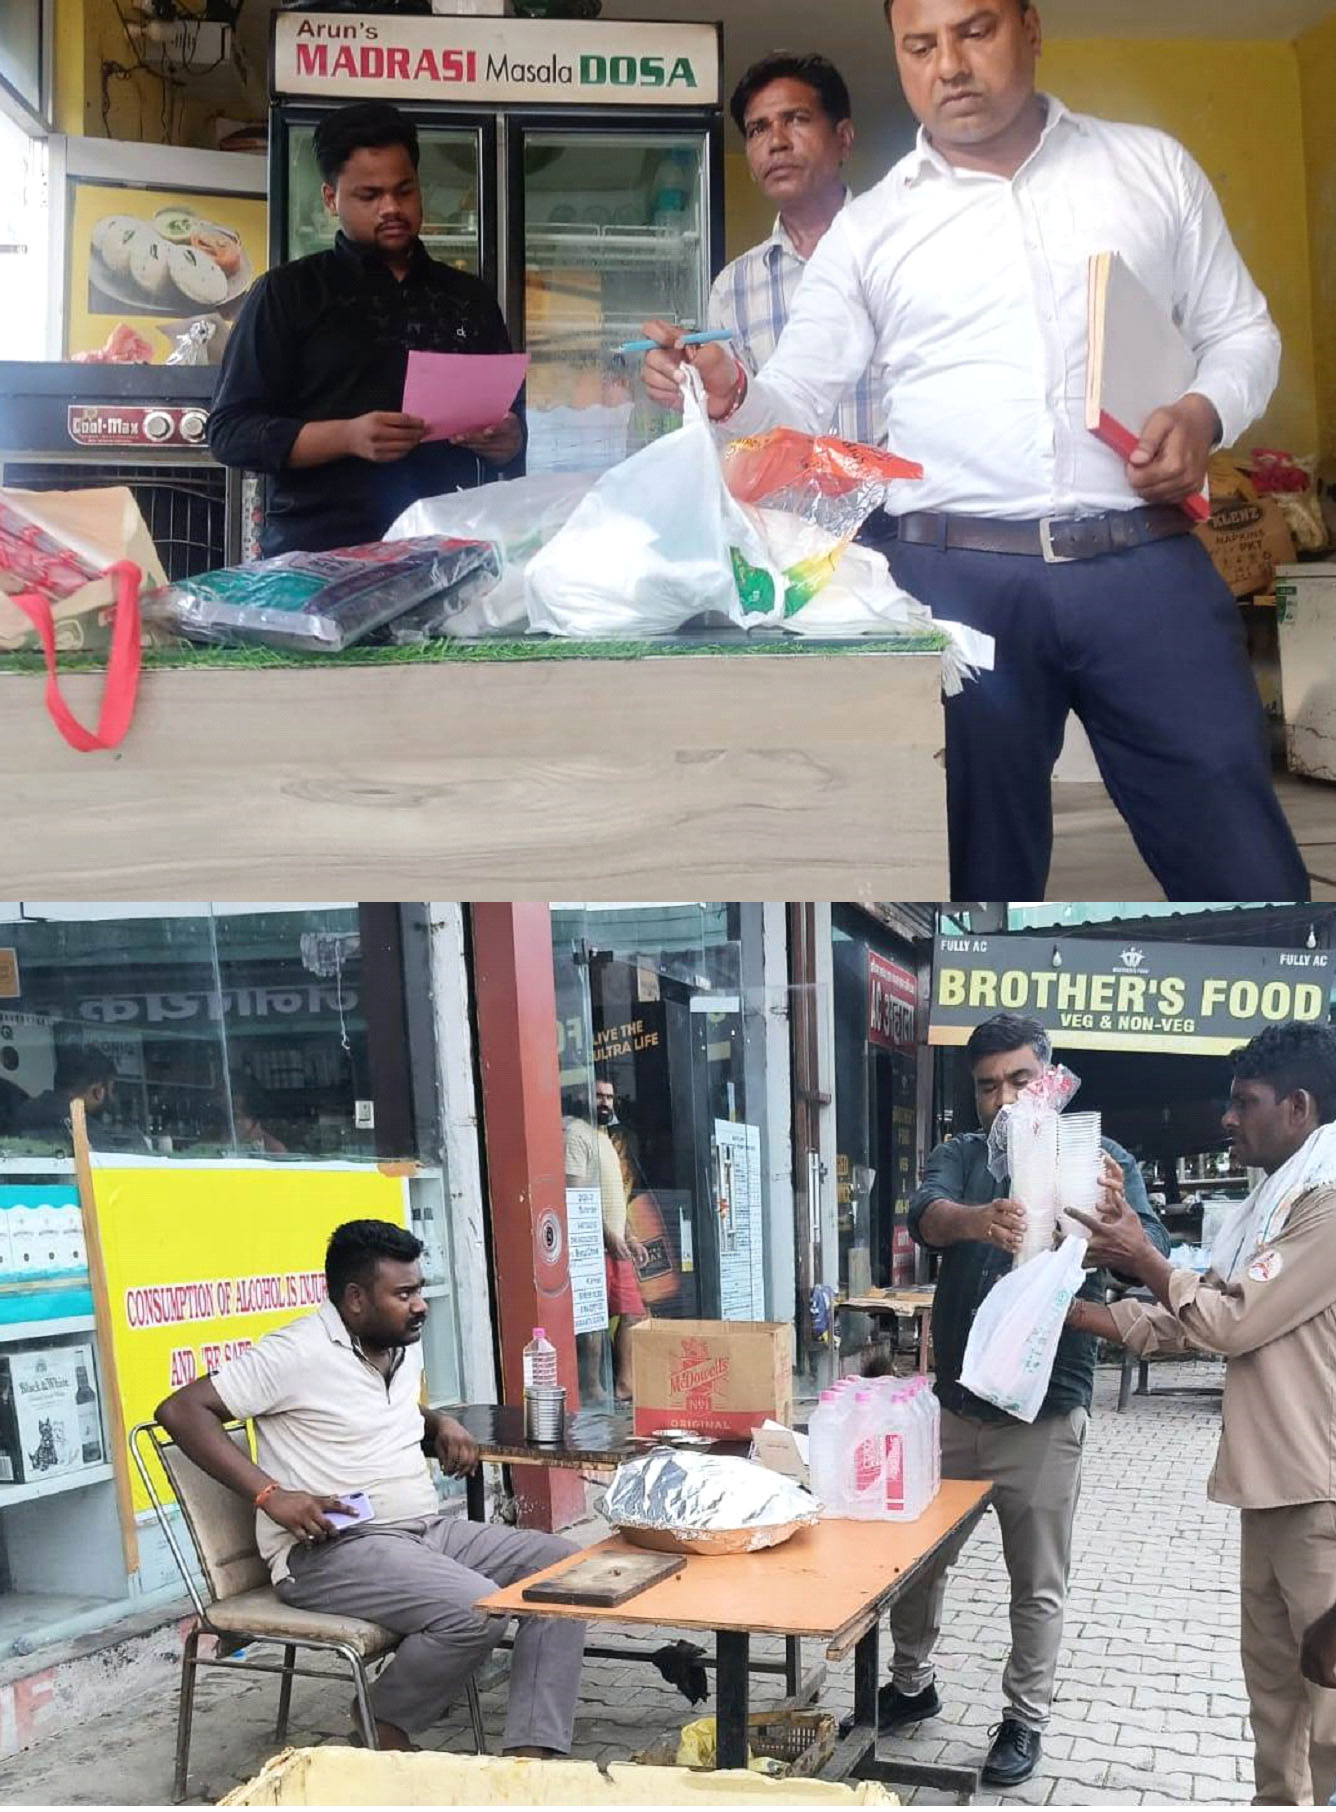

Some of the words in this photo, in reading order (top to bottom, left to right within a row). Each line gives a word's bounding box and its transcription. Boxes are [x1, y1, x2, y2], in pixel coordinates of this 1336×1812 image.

[297, 20, 378, 40] Arun's
[296, 44, 477, 82] MADRASI
[485, 54, 572, 84] Masala
[580, 55, 698, 87] DOSA
[941, 940, 970, 952] FULLY
[973, 941, 988, 952] AC
[1280, 954, 1311, 966] FULLY
[1313, 955, 1328, 967] AC
[938, 969, 1185, 1015] BROTHER'S
[1202, 980, 1322, 1021] FOOD
[593, 1028, 618, 1046] LIVE
[620, 1020, 643, 1037] THE
[1060, 1014, 1093, 1028] VEG
[1100, 1015, 1112, 1029] &
[1118, 1016, 1195, 1032] NON-VEG
[634, 1032, 659, 1050] LIFE
[127, 1283, 214, 1327] CONSUMPTION
[217, 1281, 231, 1316] OF
[236, 1276, 285, 1312] ALCOHOL
[286, 1275, 297, 1306] IS
[171, 1350, 196, 1387] AND
[670, 1419, 731, 1430] ORIGINAL
